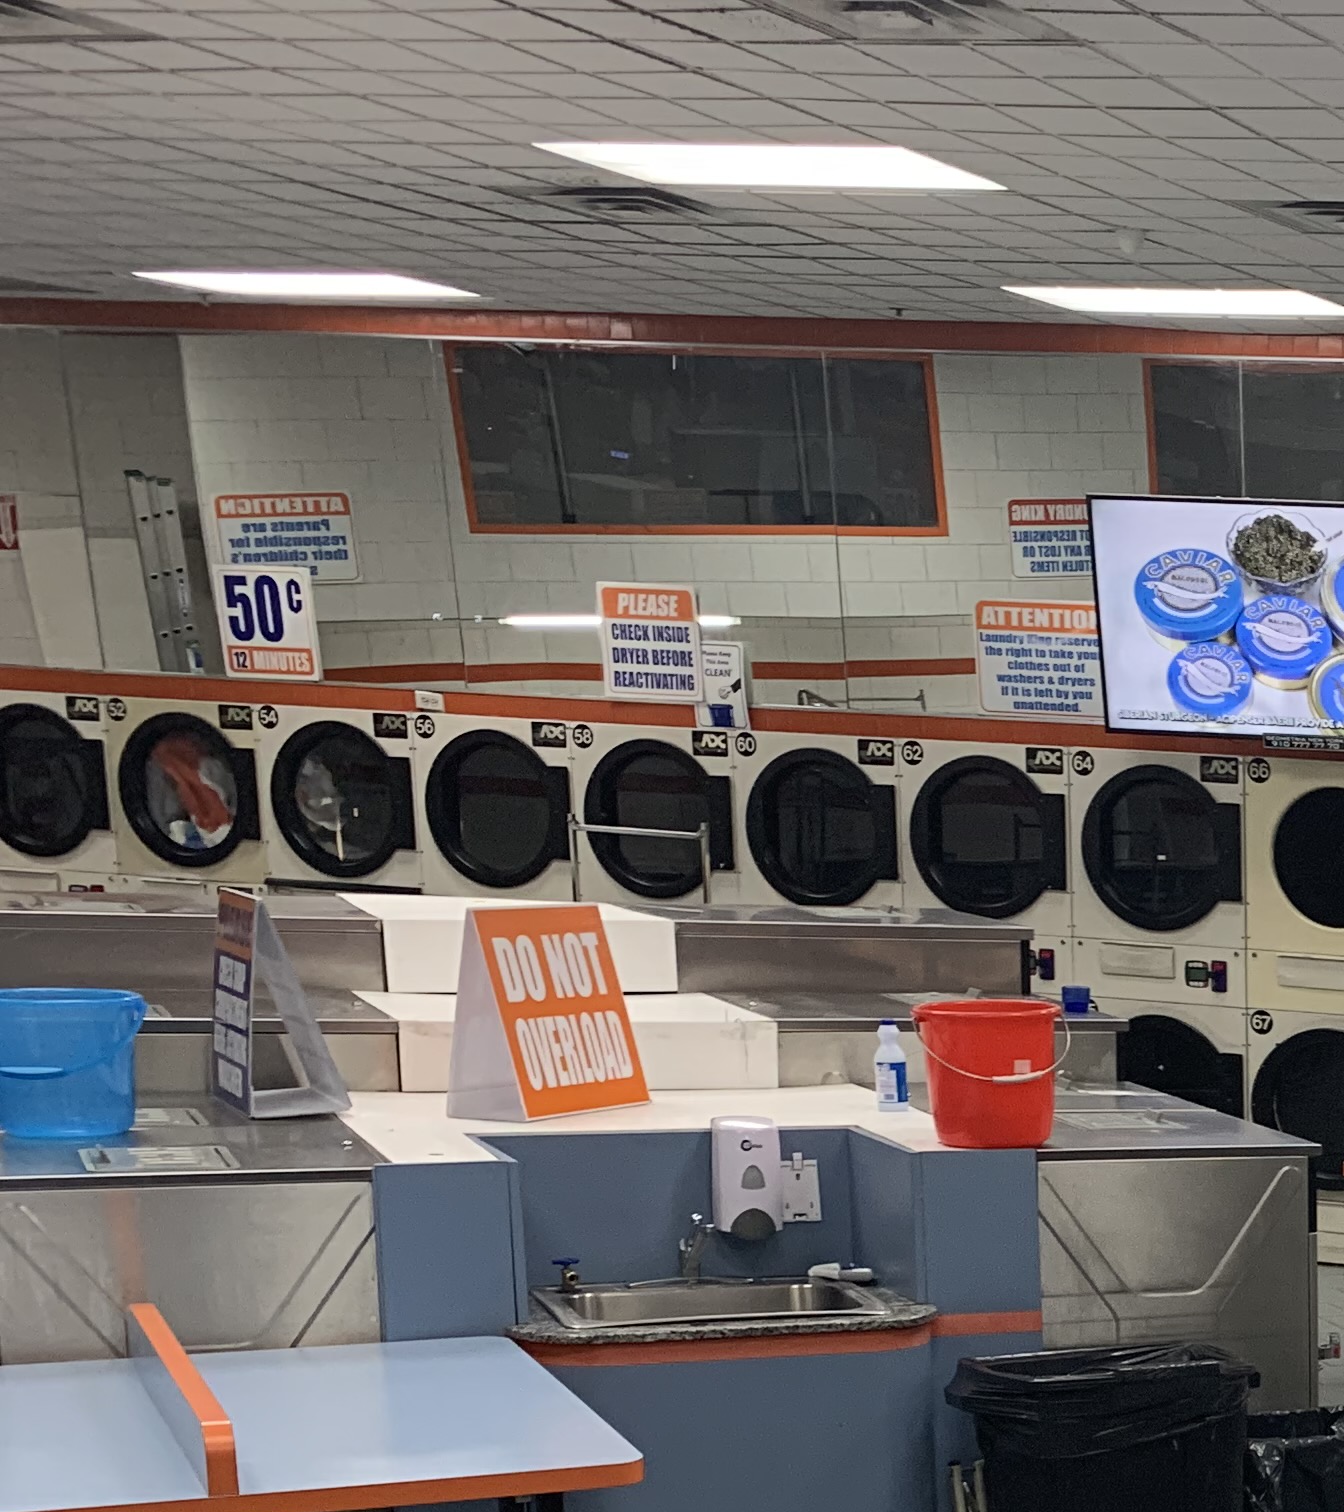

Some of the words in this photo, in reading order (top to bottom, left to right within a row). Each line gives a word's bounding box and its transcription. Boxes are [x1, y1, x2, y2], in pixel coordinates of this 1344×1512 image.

[1145, 551, 1236, 587] CAVIAR
[617, 593, 678, 617] PLEASE
[1244, 598, 1325, 630] CAVIAR
[611, 623, 650, 641] CHECK
[652, 626, 690, 643] INSIDE
[980, 632, 1024, 645] Laundry
[234, 652, 248, 668] 12
[252, 650, 310, 672] MINUTES
[612, 647, 649, 665] DRYER
[652, 649, 693, 667] BEFORE
[985, 646, 1003, 656] the
[1005, 647, 1032, 659] right
[1035, 649, 1046, 658] to
[1049, 649, 1075, 660] take
[1007, 660, 1050, 672] clothes
[1053, 662, 1071, 672] out
[1074, 663, 1085, 673] of
[1184, 644, 1248, 684] CAVIAR
[705, 668, 731, 677] CLEAN
[997, 673, 1044, 685] washers
[1058, 675, 1095, 687] dryers
[614, 671, 695, 691] REACTIVATING
[1001, 686, 1009, 696] if
[1011, 686, 1019, 697] it
[1022, 686, 1031, 697] is
[1034, 687, 1053, 698] left
[1055, 688, 1070, 700] by
[1072, 690, 1093, 700] you
[110, 703, 125, 716] 52
[1013, 700, 1081, 713] unattended.
[259, 709, 277, 724] 54
[416, 719, 434, 734] 56
[574, 728, 591, 744] 58
[737, 736, 755, 752] 60
[904, 745, 922, 761] 62
[1074, 755, 1093, 771] 64
[1249, 763, 1269, 780] 66
[491, 934, 547, 1003] DO
[540, 932, 608, 999] NOT
[1252, 1015, 1271, 1031] 67
[515, 1010, 634, 1091] OVERLOAD
